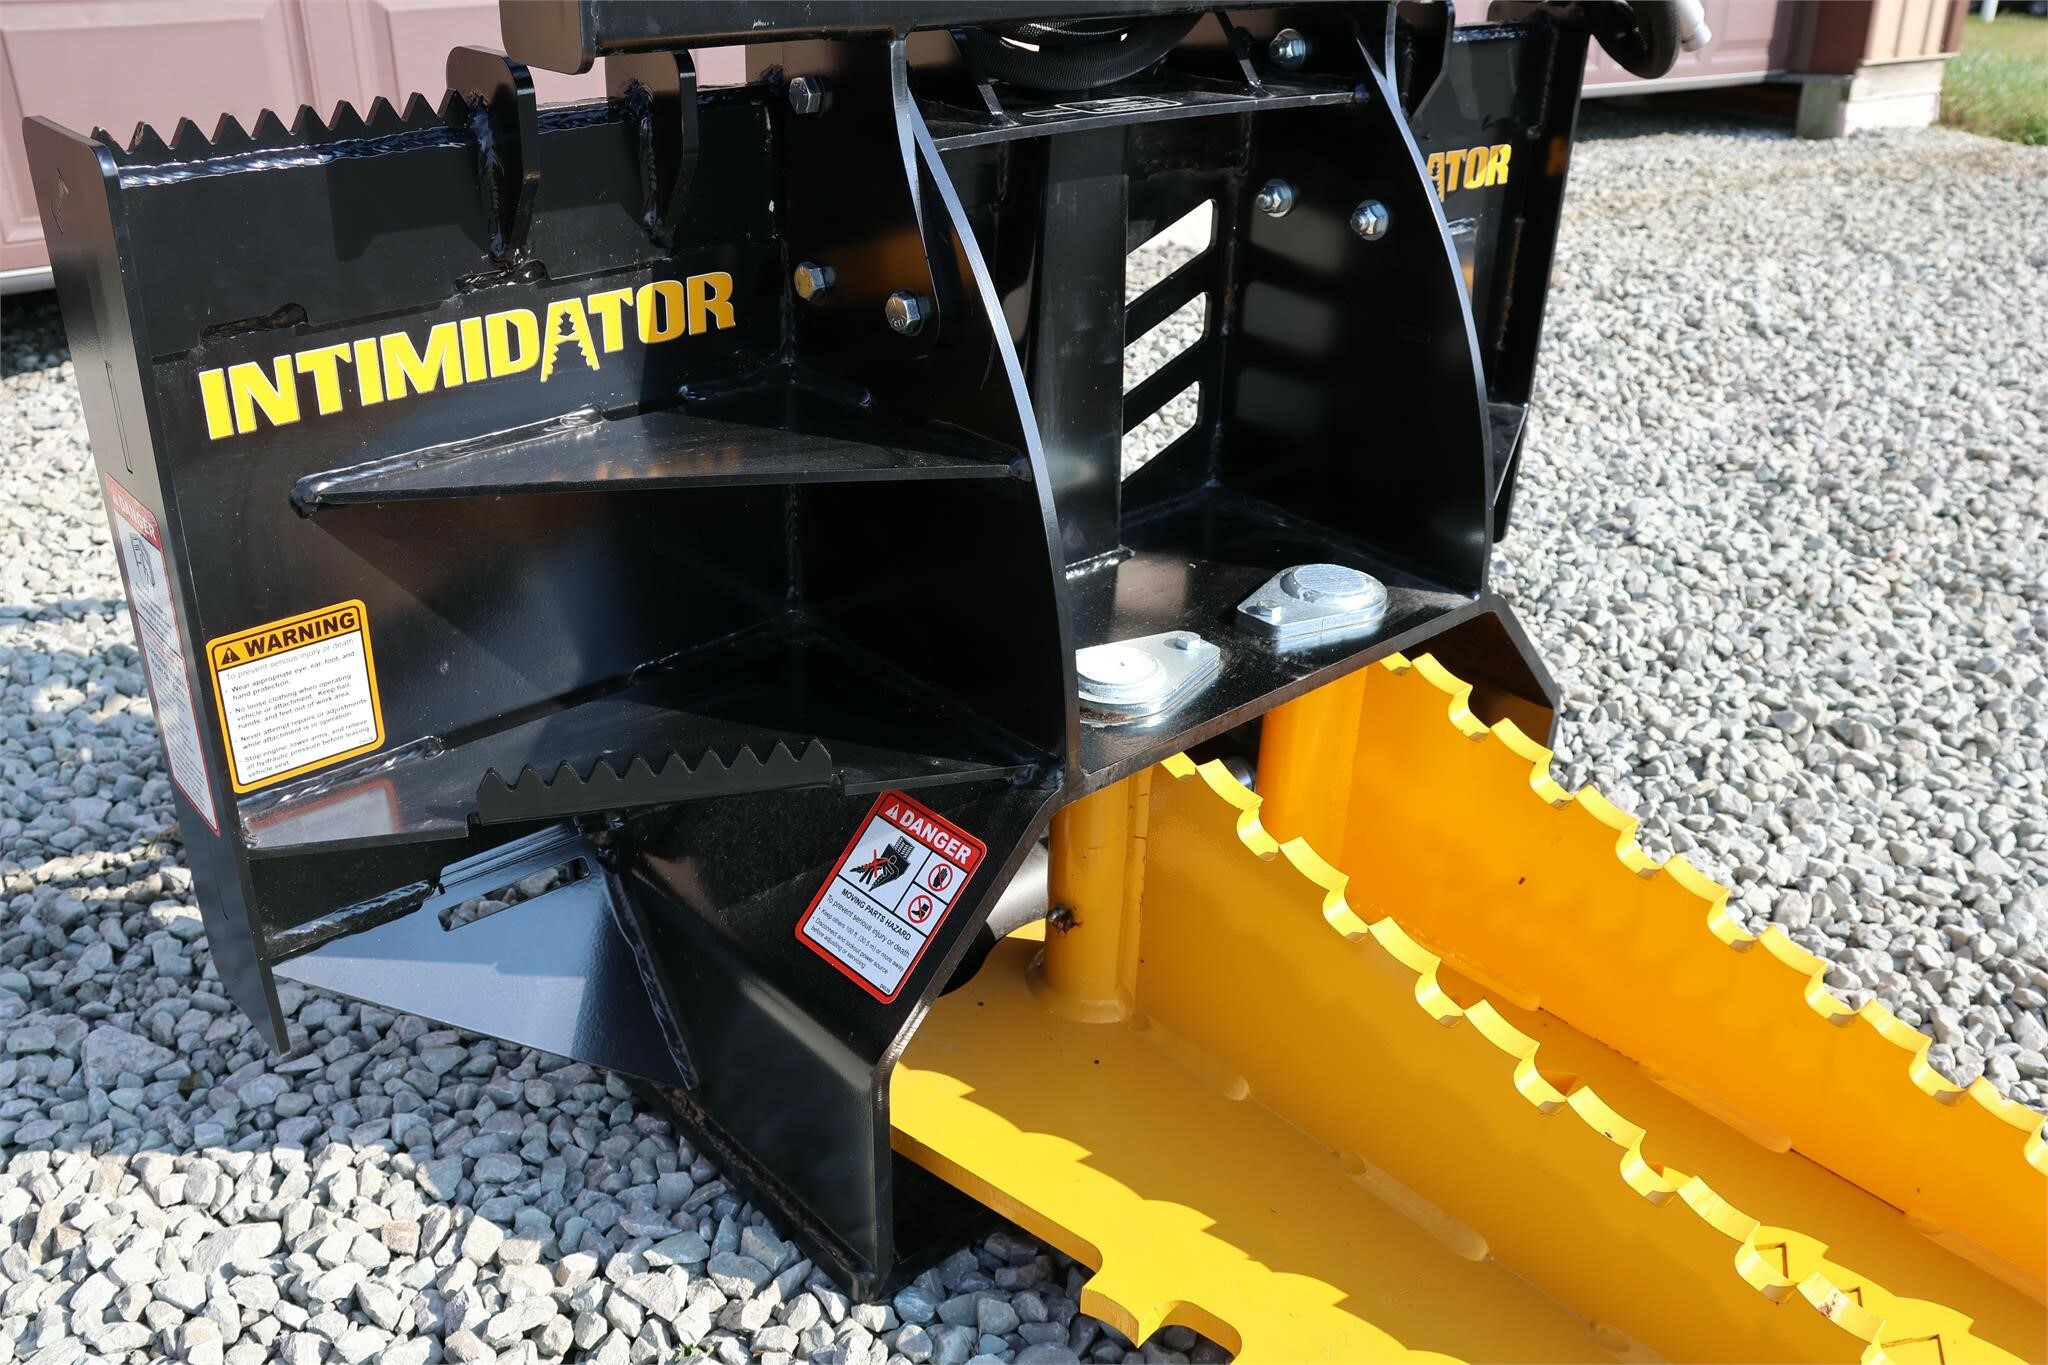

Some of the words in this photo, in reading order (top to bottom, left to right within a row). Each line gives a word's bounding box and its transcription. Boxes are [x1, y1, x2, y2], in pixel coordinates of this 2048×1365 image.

[199, 271, 736, 440] INTIMIDATOR
[120, 496, 157, 541] DANGER
[244, 612, 355, 657] WARNING
[231, 683, 249, 692] Wear
[252, 670, 292, 686] appropriate
[342, 651, 354, 659] and
[238, 663, 267, 678] prevent
[269, 655, 298, 668] serious
[300, 649, 320, 658] injury
[232, 691, 251, 700] hand
[246, 700, 266, 710] loose
[268, 691, 297, 703] clothing
[299, 685, 317, 693] when
[319, 674, 351, 687] operating
[237, 710, 262, 721] vehicle
[240, 732, 260, 741] Never
[263, 722, 289, 735] attempt
[291, 715, 315, 726] repairs
[326, 699, 366, 715] adjustments
[264, 713, 277, 721] and
[243, 741, 260, 749] while
[263, 727, 301, 743] attachment
[244, 754, 261, 762] Stop
[290, 738, 308, 747] lower
[345, 720, 367, 729] relieve
[256, 753, 287, 766] hydraulic
[290, 742, 320, 756] pressure
[322, 735, 343, 745] before
[345, 727, 369, 736] leaving
[899, 810, 972, 864] DANGER
[832, 901, 853, 917] prevent
[852, 914, 872, 931] serious
[872, 928, 887, 942] injury
[841, 888, 865, 908] MOVING
[864, 904, 885, 922] PARTS
[884, 919, 911, 940] HAZARD
[810, 924, 824, 937] before
[824, 935, 842, 952] adjusting
[815, 917, 838, 937] Disconnect
[837, 934, 846, 943] and
[845, 940, 861, 954] lockout
[859, 951, 874, 963] power
[873, 961, 888, 974] source
[821, 909, 832, 919] Keep
[832, 917, 845, 928] others
[846, 926, 854, 934] 100
[880, 952, 892, 963] more
